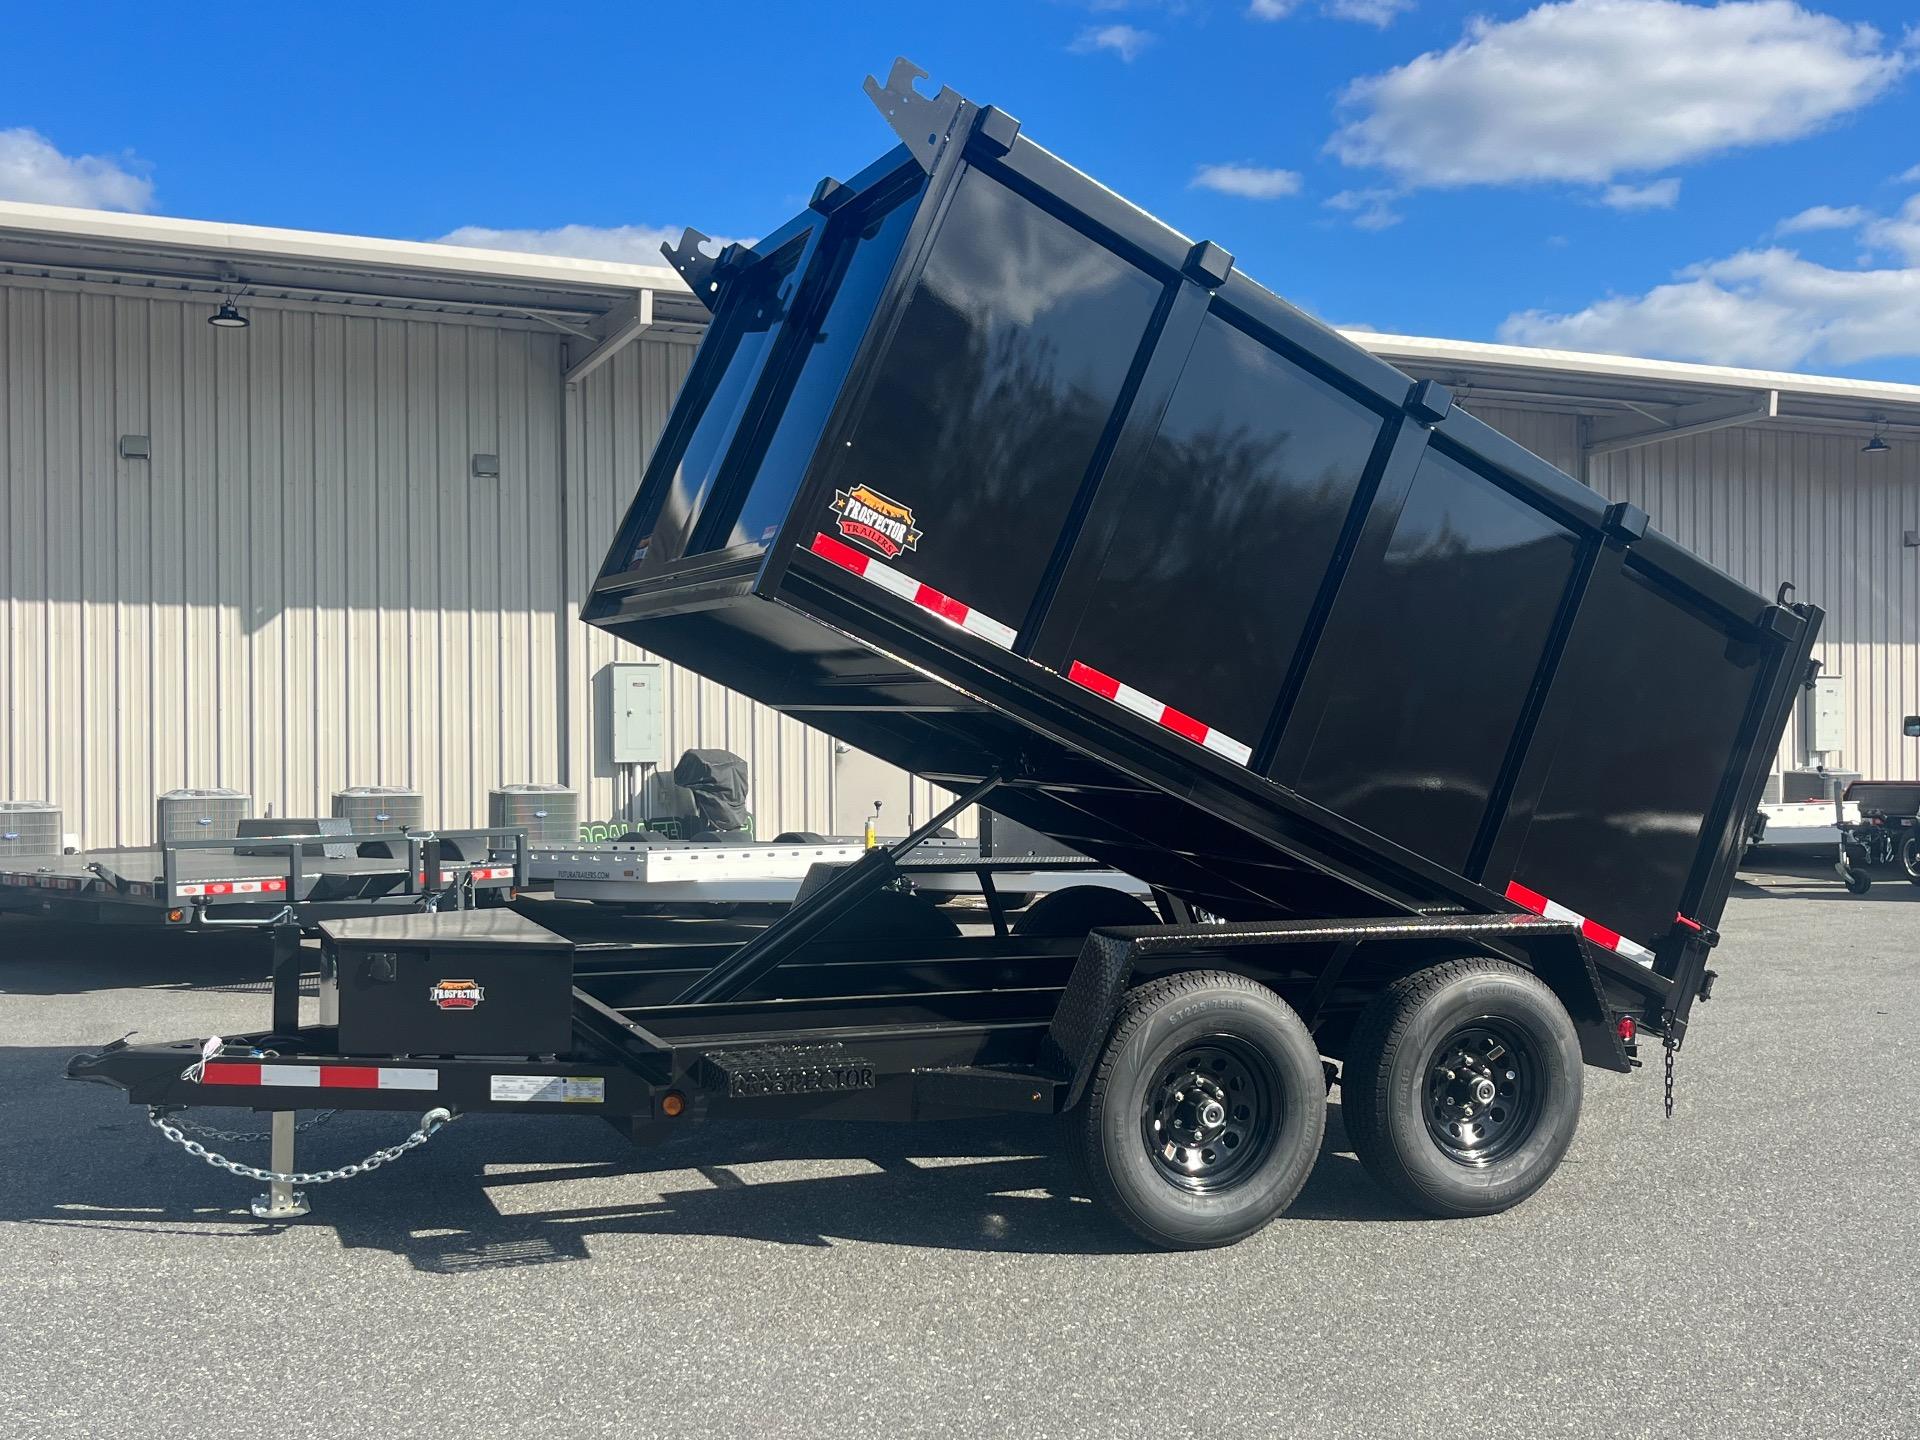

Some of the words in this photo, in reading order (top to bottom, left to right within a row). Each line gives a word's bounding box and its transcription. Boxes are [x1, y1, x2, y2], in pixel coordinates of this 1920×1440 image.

[843, 497, 907, 543] PROSPECTOR
[845, 523, 894, 553] TRAILERS
[434, 989, 481, 999] PROSPECTOR
